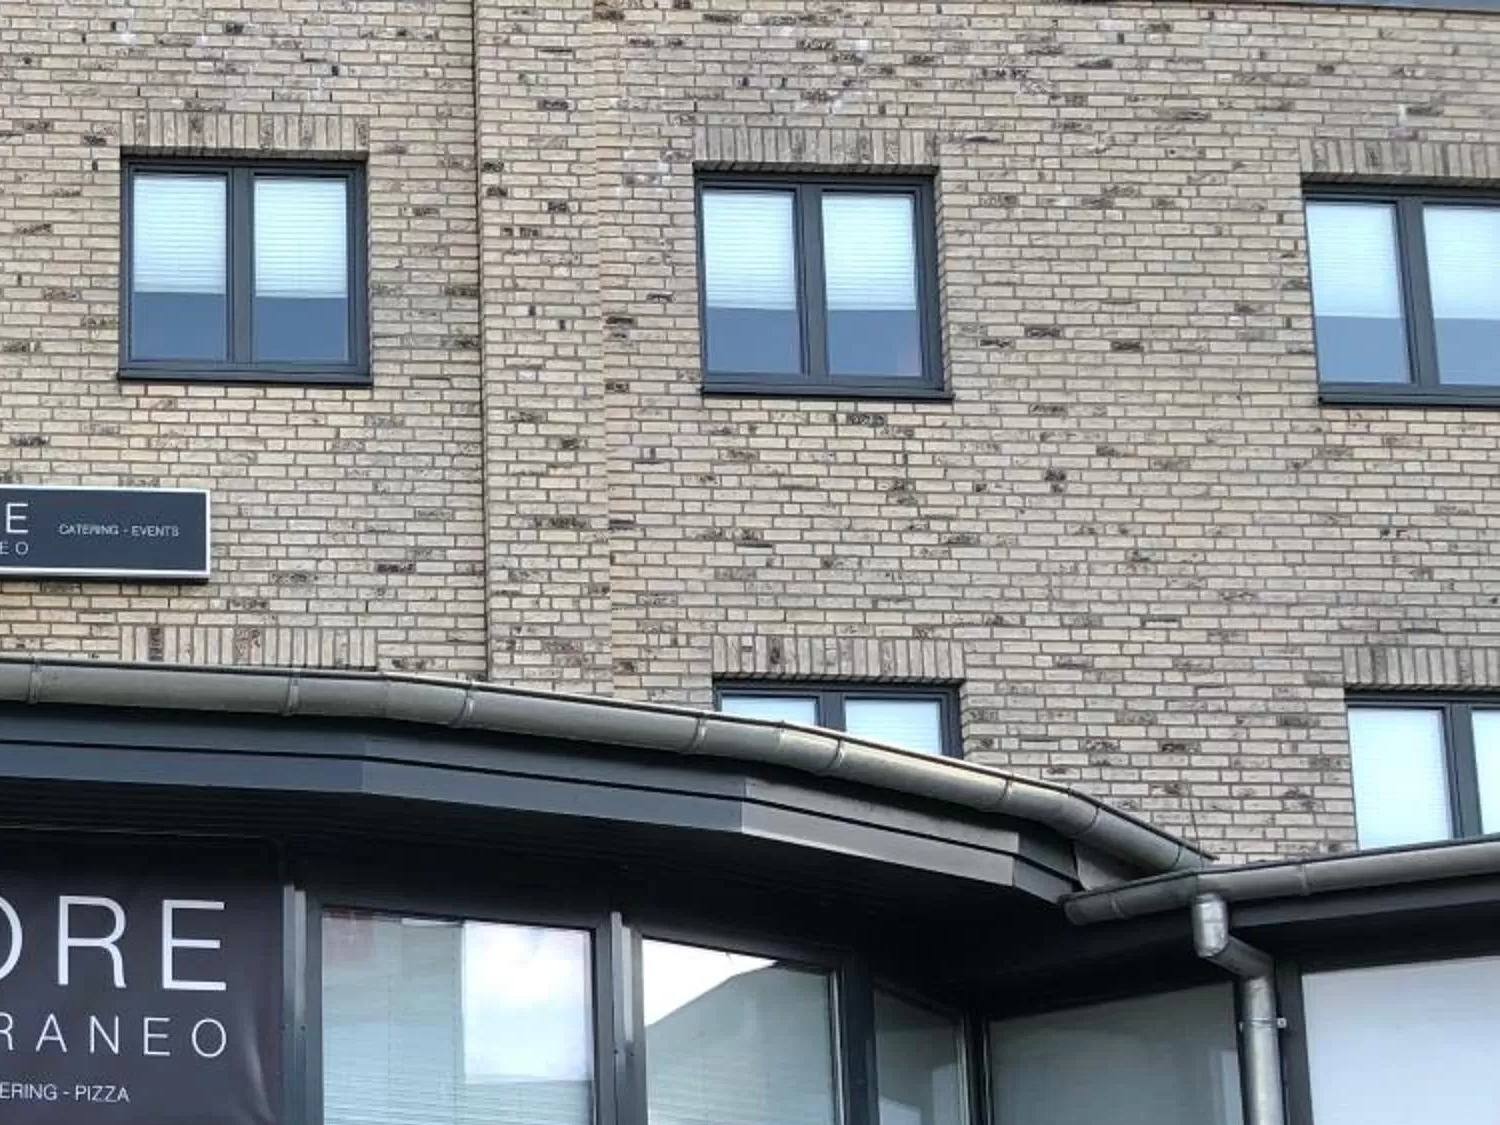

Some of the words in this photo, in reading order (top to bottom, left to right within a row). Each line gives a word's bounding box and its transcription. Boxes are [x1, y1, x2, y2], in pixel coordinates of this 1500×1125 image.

[58, 523, 119, 535] CATERING
[131, 525, 180, 537] EVENTS
[75, 1084, 130, 1103] PIZZA
